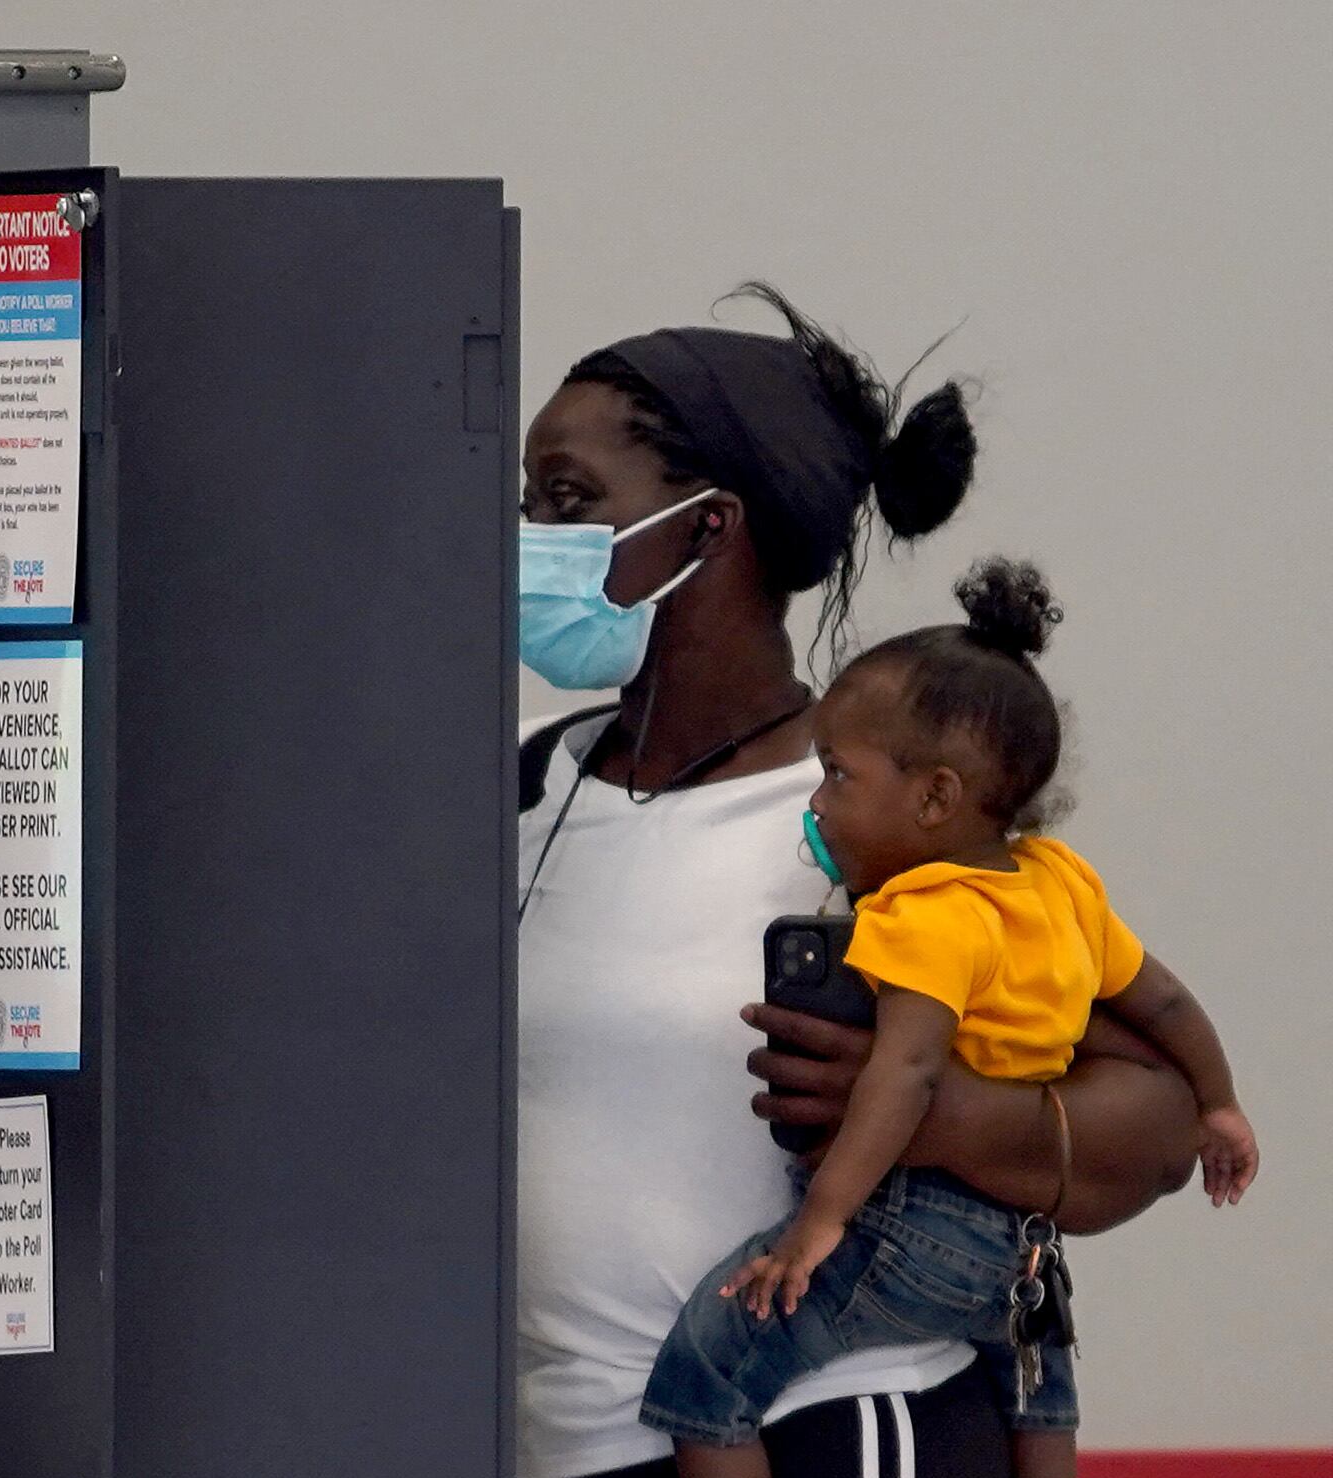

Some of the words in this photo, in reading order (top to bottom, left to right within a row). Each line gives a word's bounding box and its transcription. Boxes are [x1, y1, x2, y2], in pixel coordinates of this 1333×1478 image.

[8, 244, 49, 270] VOTERS
[14, 680, 47, 703] YOUR
[41, 747, 67, 769] CAN
[43, 781, 55, 802] IN
[20, 814, 60, 836] PRINT.
[12, 874, 33, 897] SEE
[38, 874, 66, 897] OUR
[4, 907, 58, 930] OFFICIAL
[0, 1128, 29, 1147] Please
[21, 1167, 41, 1188] your
[20, 1199, 41, 1219] Card
[5, 1237, 20, 1257] the
[23, 1235, 41, 1255] Poll
